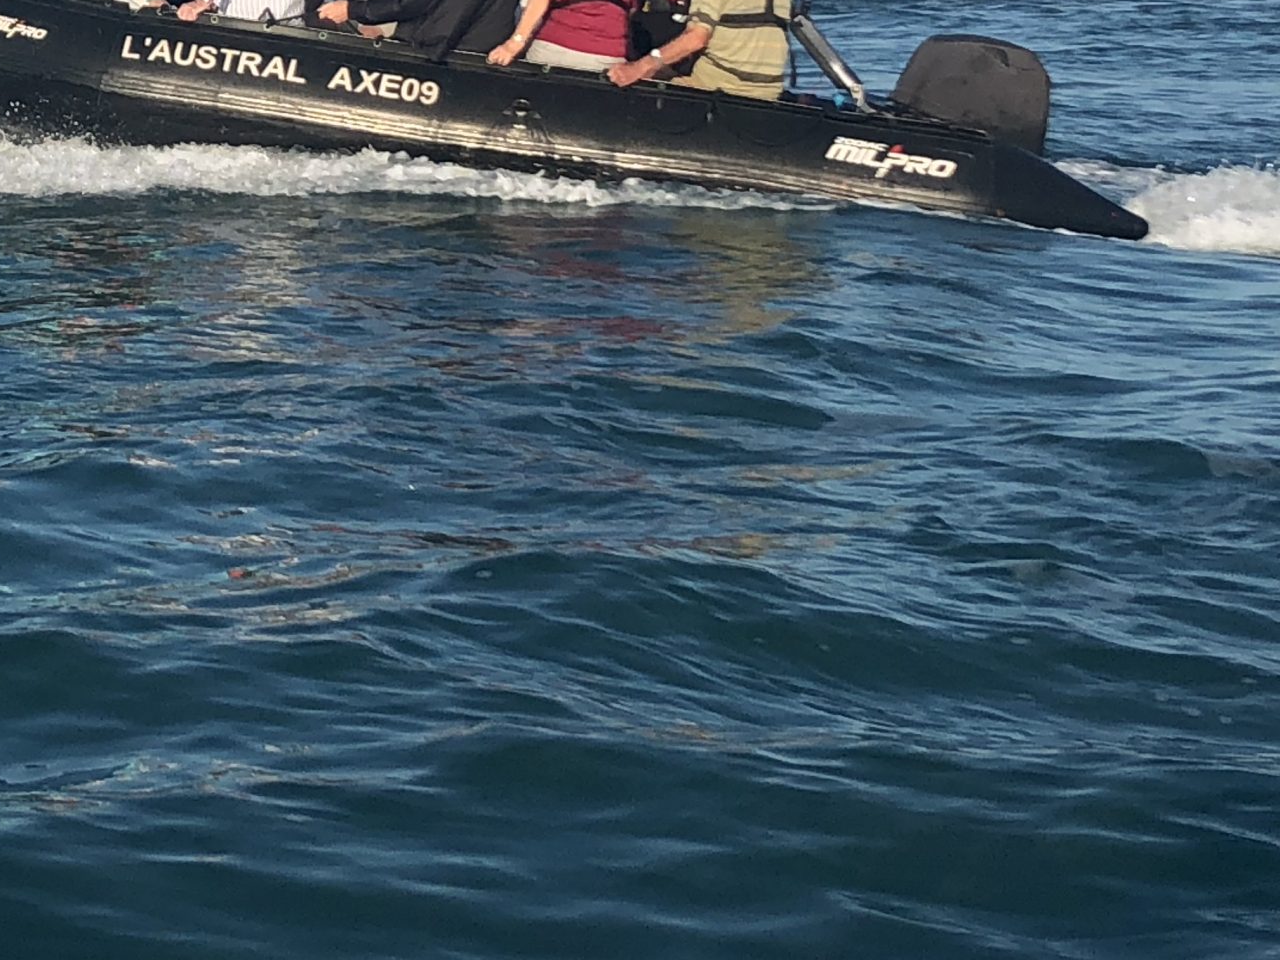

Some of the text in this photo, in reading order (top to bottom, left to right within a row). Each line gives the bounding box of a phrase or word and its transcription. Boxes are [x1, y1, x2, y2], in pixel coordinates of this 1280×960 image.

[121, 35, 440, 105] L'AUSTRAL AXE09
[824, 143, 958, 178] MILPRO
